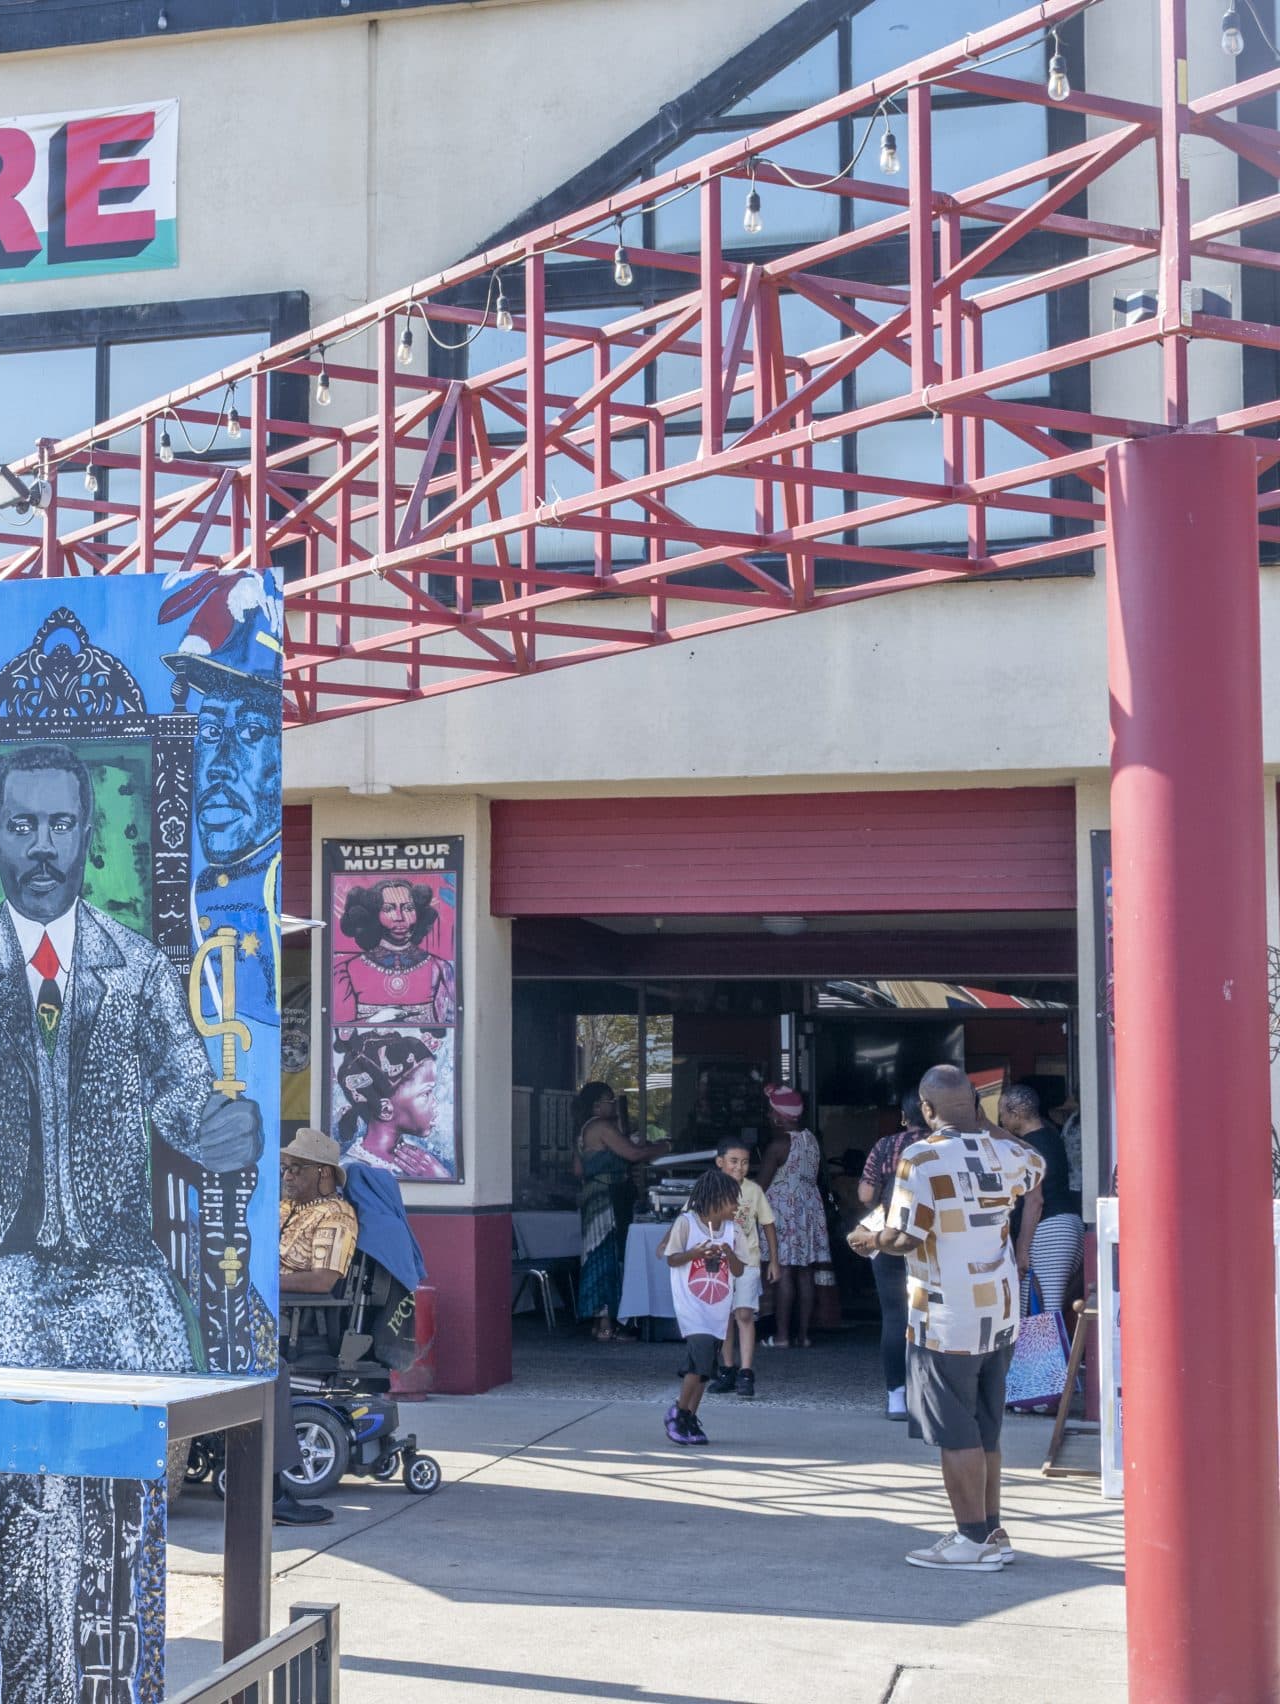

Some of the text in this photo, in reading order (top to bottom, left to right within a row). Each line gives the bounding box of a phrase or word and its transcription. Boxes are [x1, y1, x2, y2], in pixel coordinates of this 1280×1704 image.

[339, 843, 450, 857] VISIT OUR
[344, 858, 445, 871] MUSEUM
